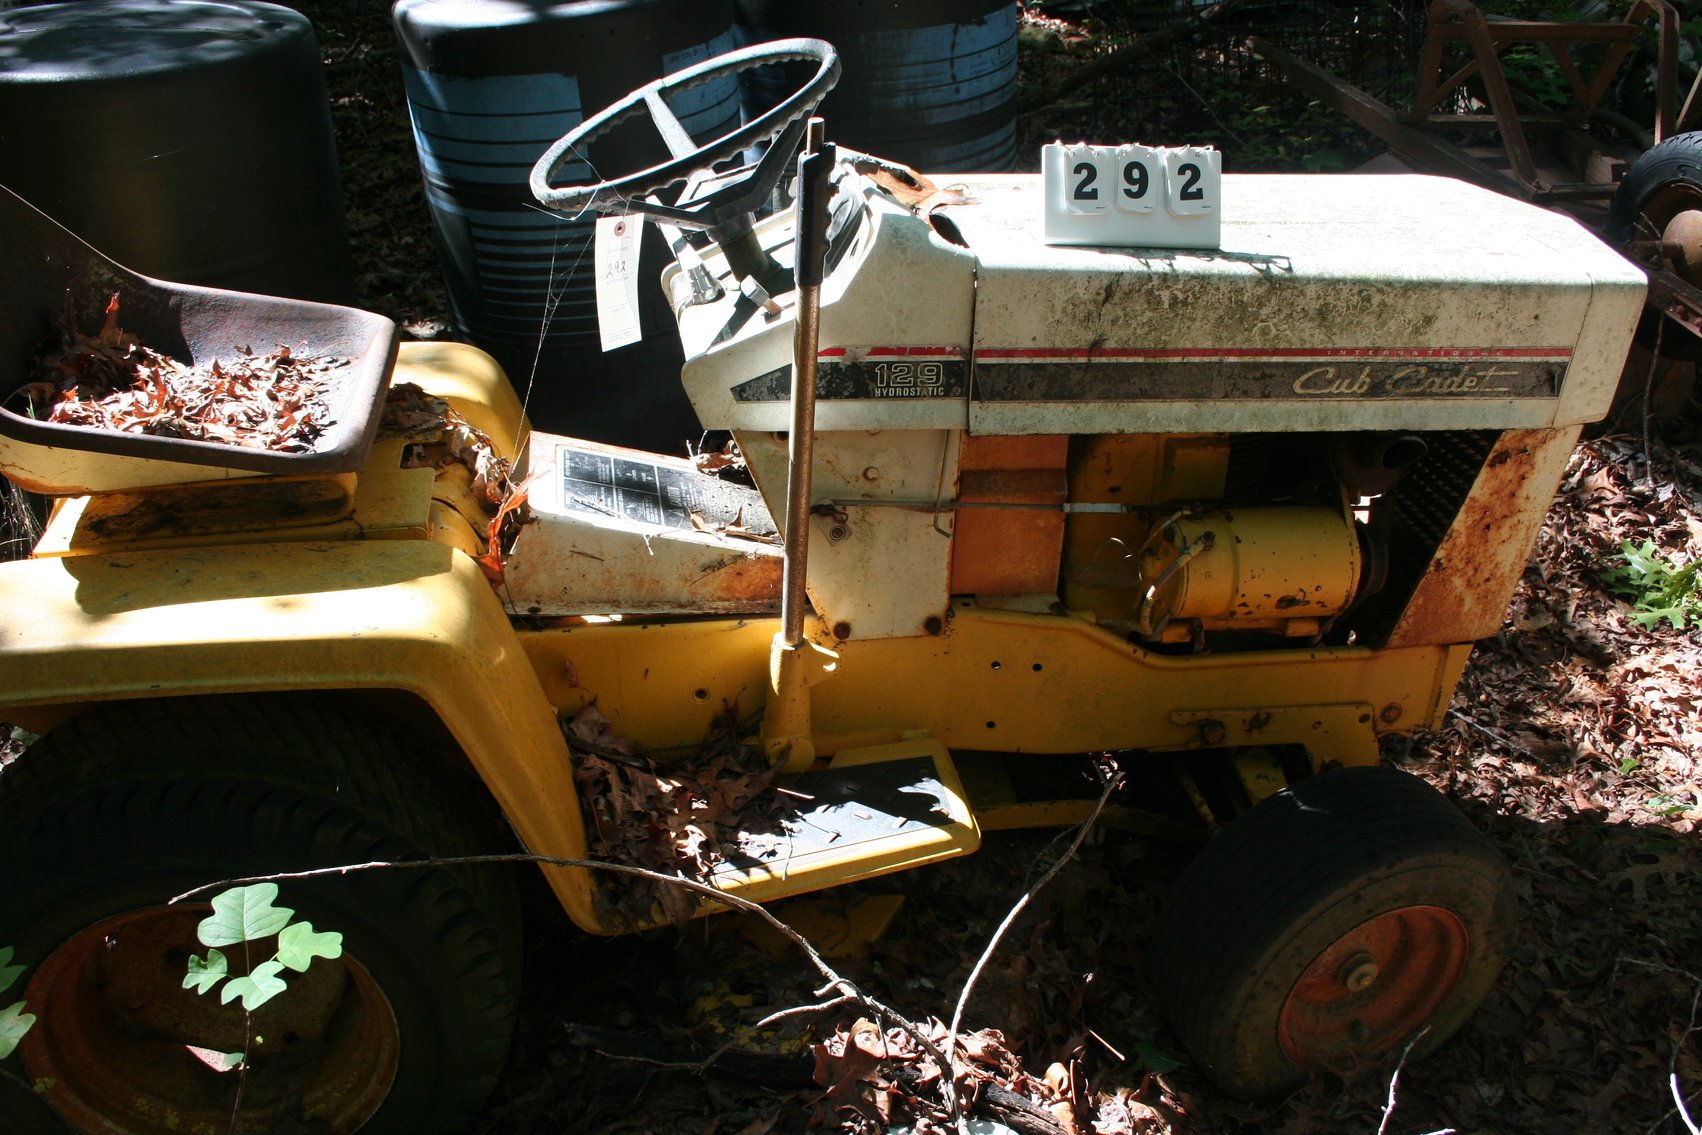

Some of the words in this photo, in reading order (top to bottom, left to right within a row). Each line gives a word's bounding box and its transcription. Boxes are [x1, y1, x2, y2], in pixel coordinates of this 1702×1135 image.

[1073, 161, 1204, 200] 292
[606, 260, 626, 279] 292
[875, 363, 943, 387] 129
[1293, 366, 1372, 394] Cub
[1385, 364, 1519, 394] Cadet
